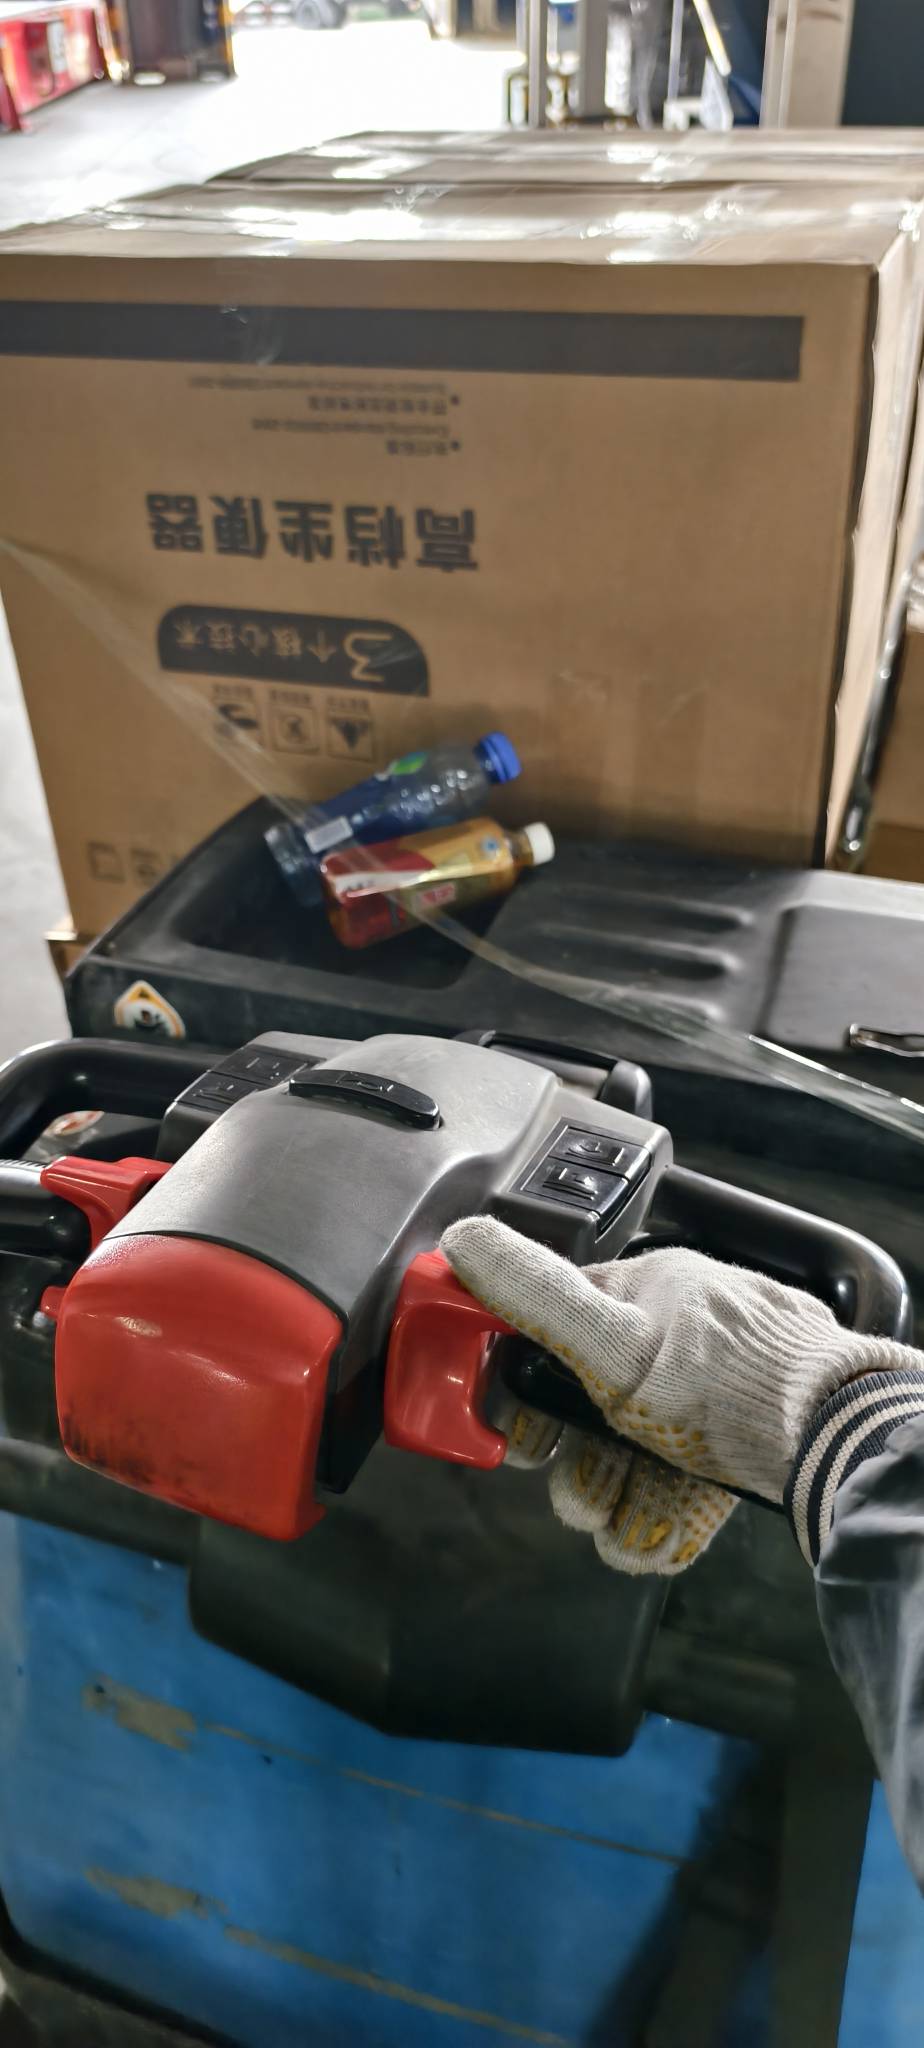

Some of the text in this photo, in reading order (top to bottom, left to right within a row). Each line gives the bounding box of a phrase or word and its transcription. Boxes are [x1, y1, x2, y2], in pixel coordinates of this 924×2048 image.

[146, 493, 479, 574] 高档坐便器
